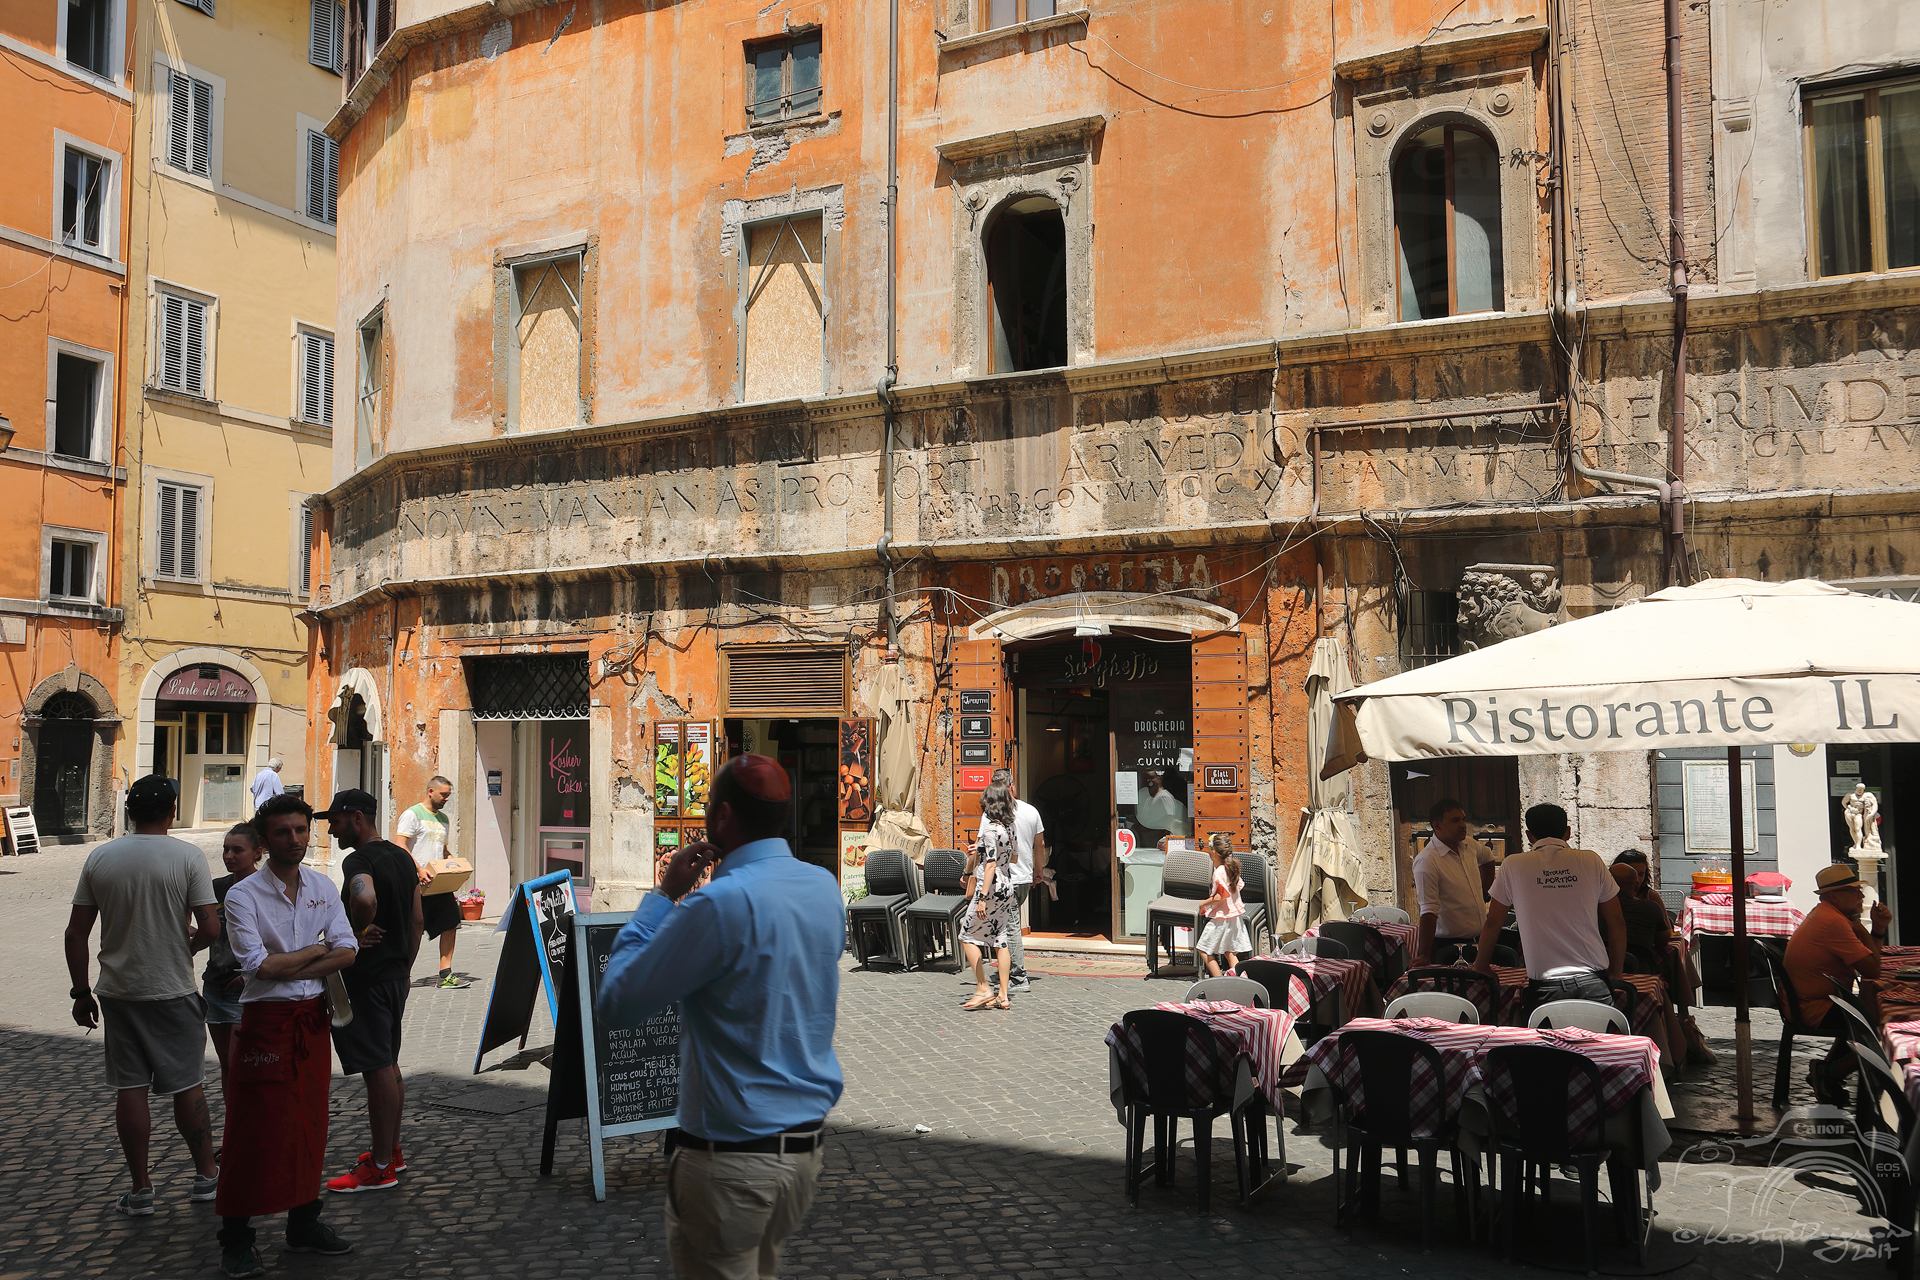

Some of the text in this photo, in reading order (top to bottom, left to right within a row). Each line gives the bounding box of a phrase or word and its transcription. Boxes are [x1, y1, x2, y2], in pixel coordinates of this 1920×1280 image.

[780, 472, 854, 511] PRO
[167, 678, 200, 696] L'arte
[1441, 679, 1898, 745] Ristorante IL
[1134, 720, 1185, 732] DROGHERIA
[1143, 739, 1177, 750] SERVIZIO
[549, 737, 581, 779] Kosher
[1137, 757, 1183, 767] CUCINA
[1212, 769, 1229, 778] Glatt
[1210, 777, 1232, 785] Kosher
[1536, 875, 1578, 885] IL PORTICO
[665, 1004, 674, 1016] 2
[646, 1014, 682, 1026] ZUCCHINE
[608, 1028, 631, 1040] PETTO
[636, 1028, 644, 1037] DI
[646, 1026, 670, 1036] POLLO
[609, 1034, 680, 1050] INSALATA VERDE
[611, 1048, 638, 1061] ACQUA
[644, 1058, 676, 1070] MENU 3
[609, 1071, 628, 1082] COUS
[629, 1069, 648, 1080] COUS
[649, 1069, 658, 1078] DI
[610, 1080, 641, 1092] HUMMUS
[610, 1089, 648, 1105] SHNITZEL
[649, 1089, 658, 1099] DI
[612, 1096, 674, 1114] PATATINE FRITTE
